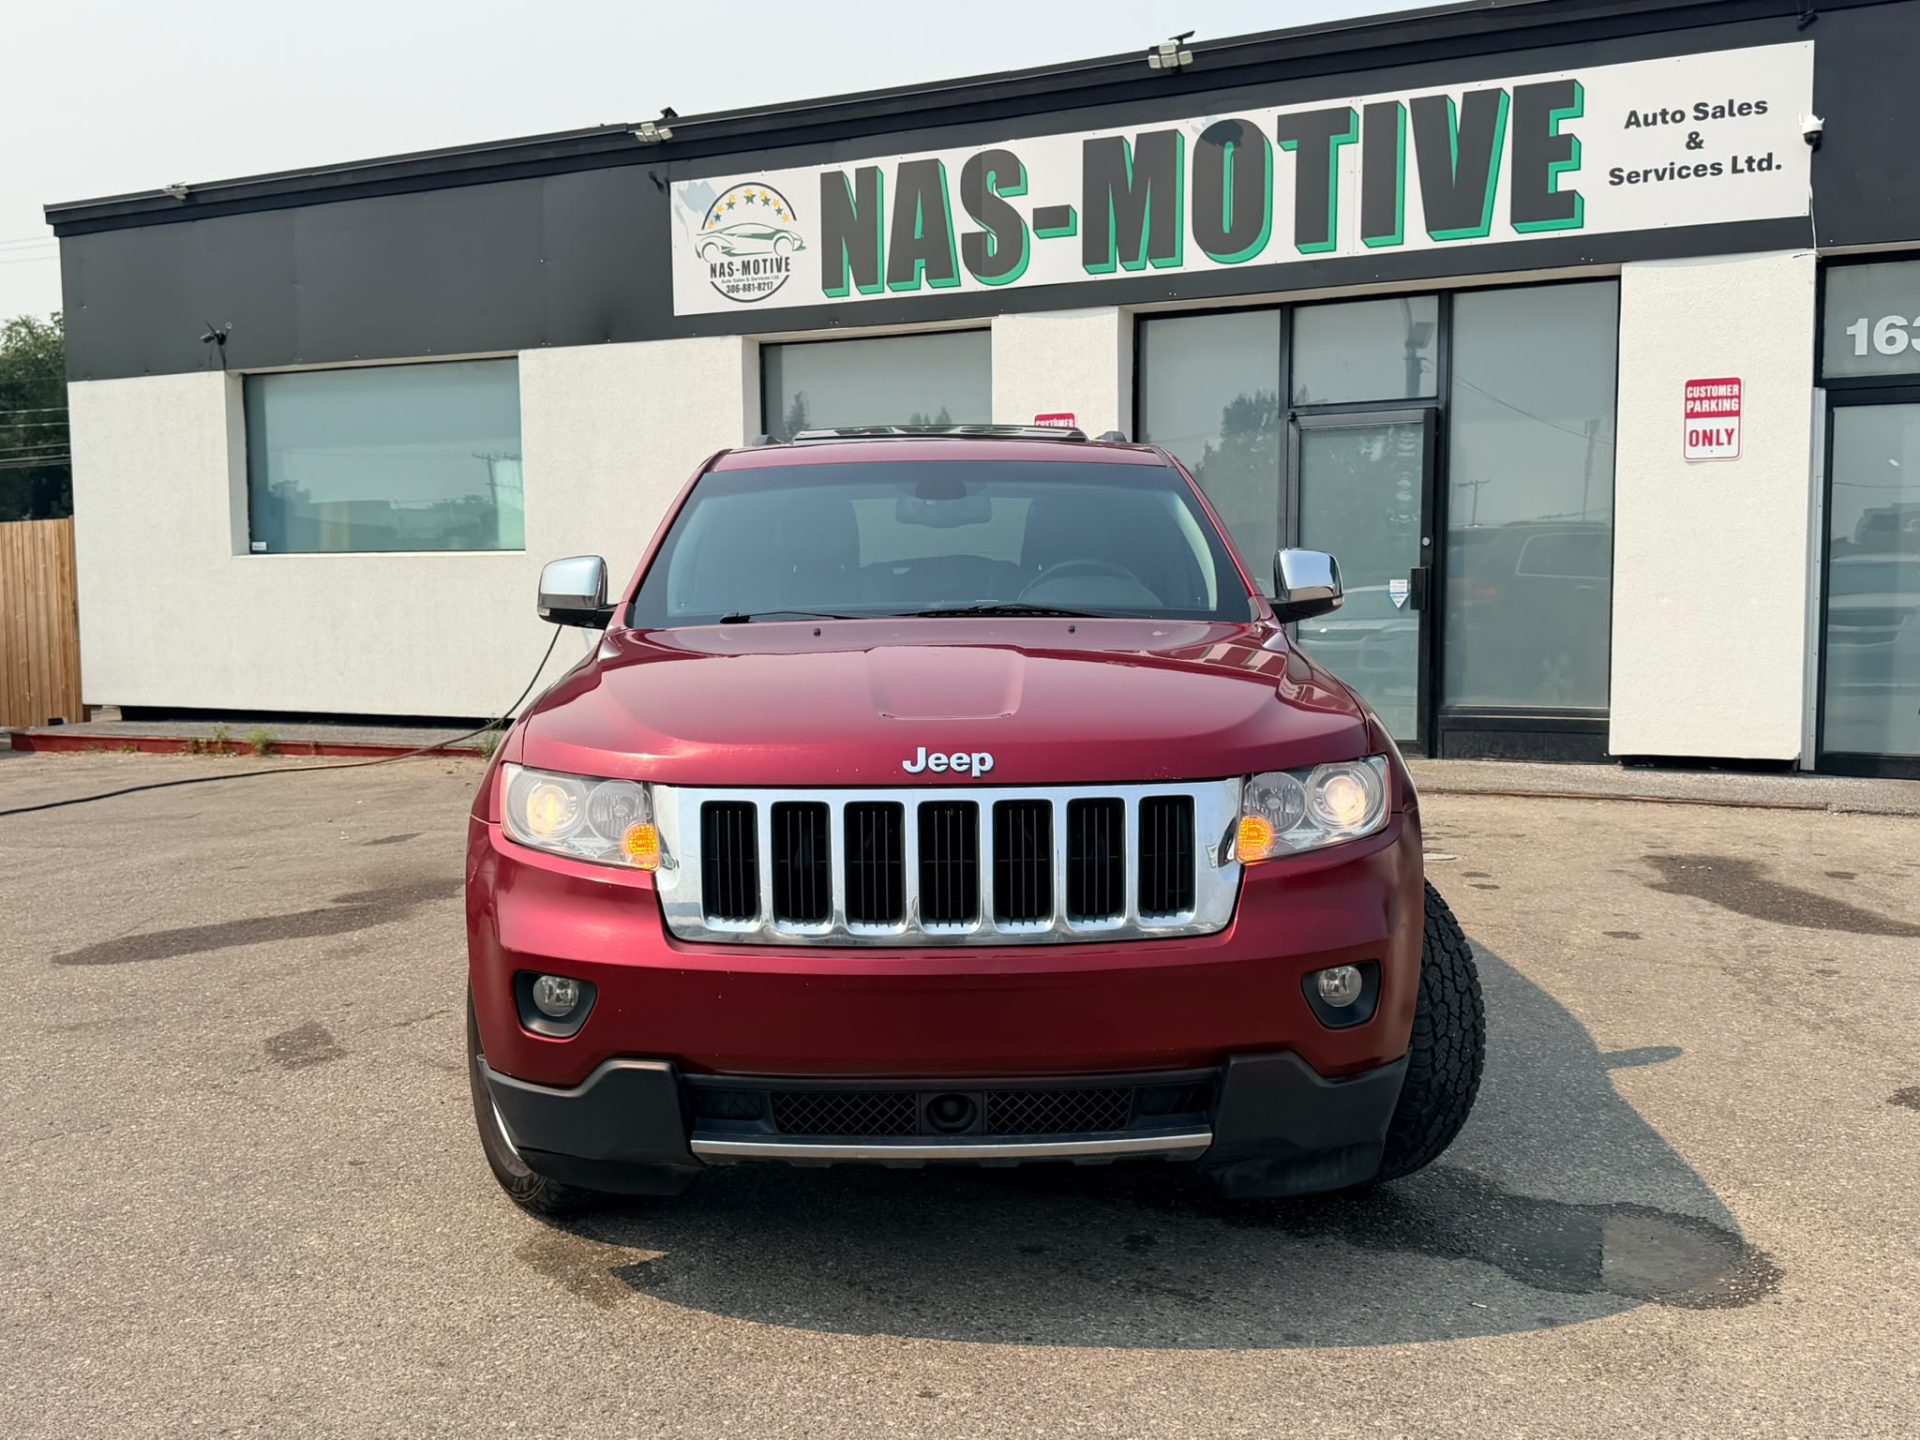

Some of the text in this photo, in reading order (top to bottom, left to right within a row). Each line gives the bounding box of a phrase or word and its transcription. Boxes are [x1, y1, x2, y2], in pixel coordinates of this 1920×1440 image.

[1624, 99, 1768, 128] Auto Sales
[1685, 131, 1704, 150] &
[1608, 152, 1782, 186] Services Ltd.
[820, 79, 1584, 300] NAS-MOTIVE
[710, 256, 790, 279] NAS-MOTIVE
[1846, 315, 1920, 356] 16
[1687, 385, 1739, 398] CUSTOMER
[1687, 399, 1739, 413] PARKING
[1689, 428, 1735, 448] ONLY
[902, 747, 994, 778] Jeep
